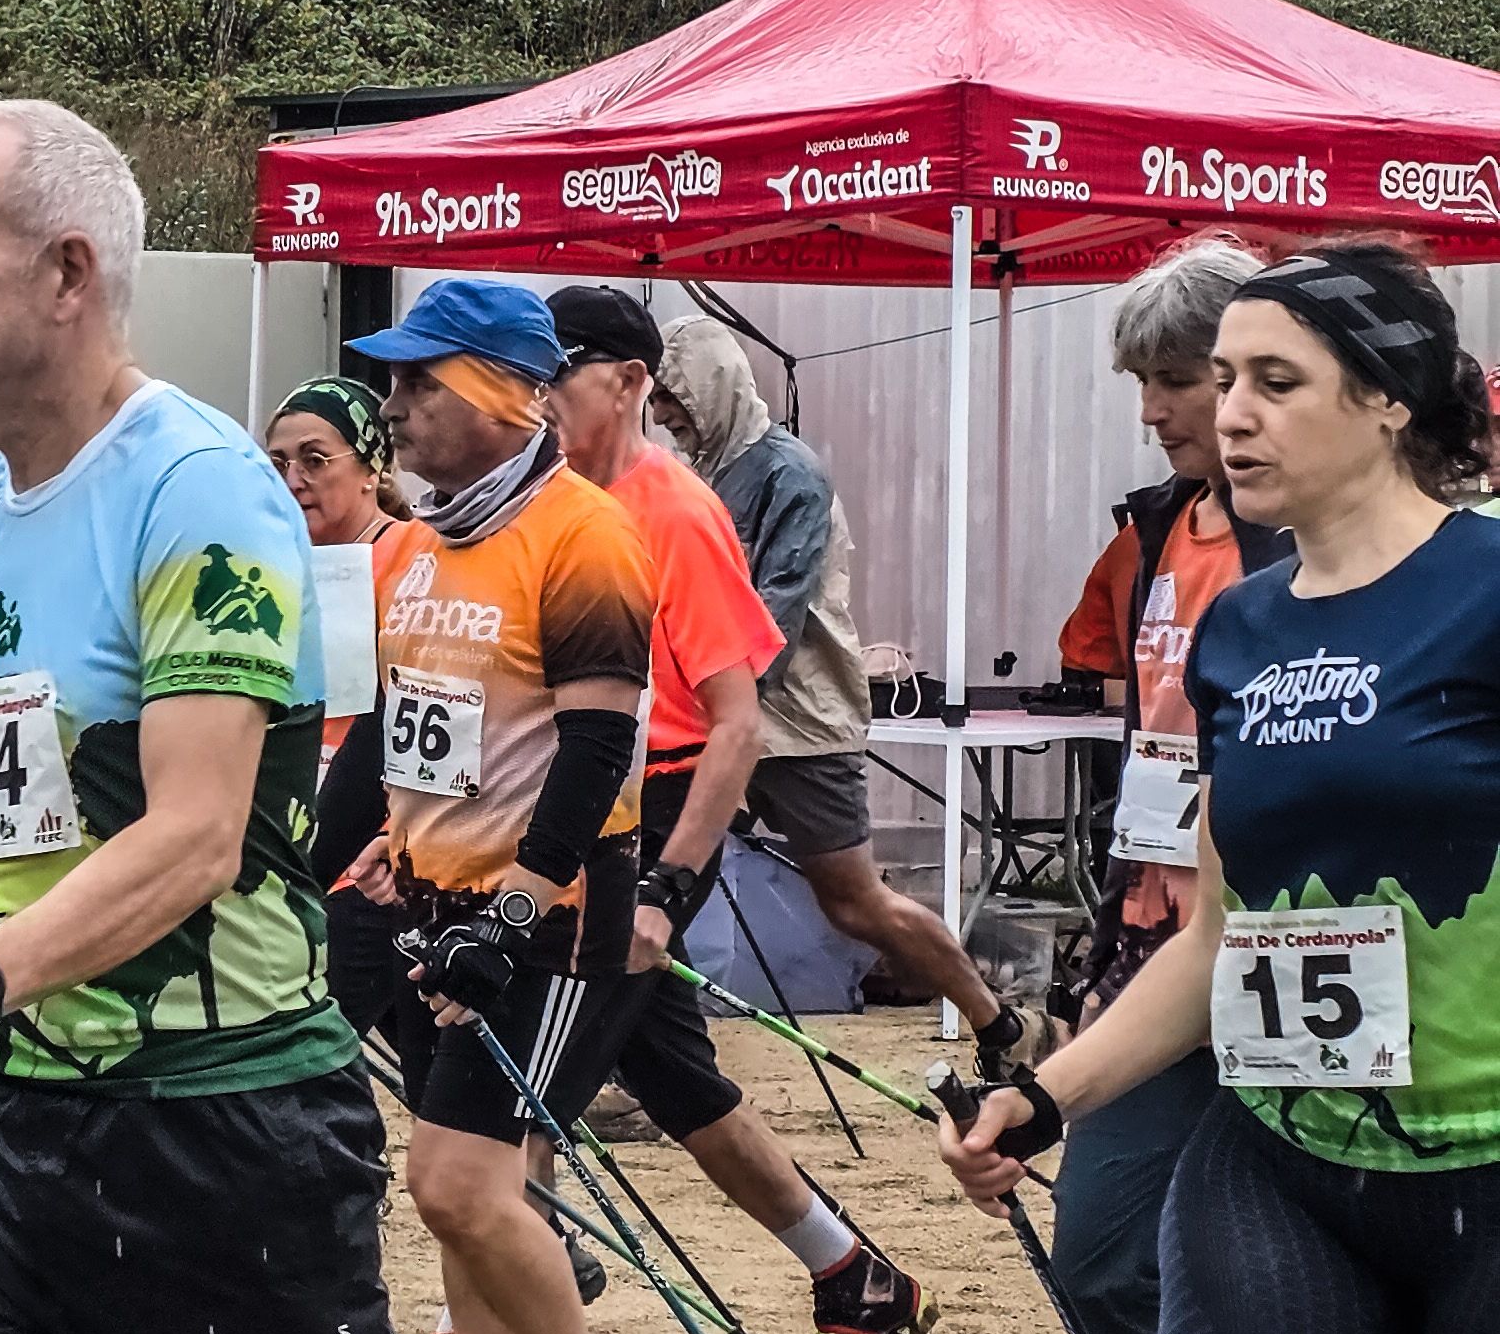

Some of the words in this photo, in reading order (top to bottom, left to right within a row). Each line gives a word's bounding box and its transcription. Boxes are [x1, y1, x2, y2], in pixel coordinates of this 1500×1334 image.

[804, 139, 845, 156] Agencia
[847, 133, 894, 152] exclusiva
[895, 130, 911, 144] de
[801, 156, 933, 205] Occident
[1141, 145, 1328, 212] 9h.Sports
[375, 183, 522, 243] 9h.Sports
[1232, 647, 1381, 744] Bastons
[390, 694, 452, 763] 56
[1255, 715, 1339, 747] AMUNT
[1256, 934, 1281, 949] De
[1241, 953, 1363, 1041] 15
